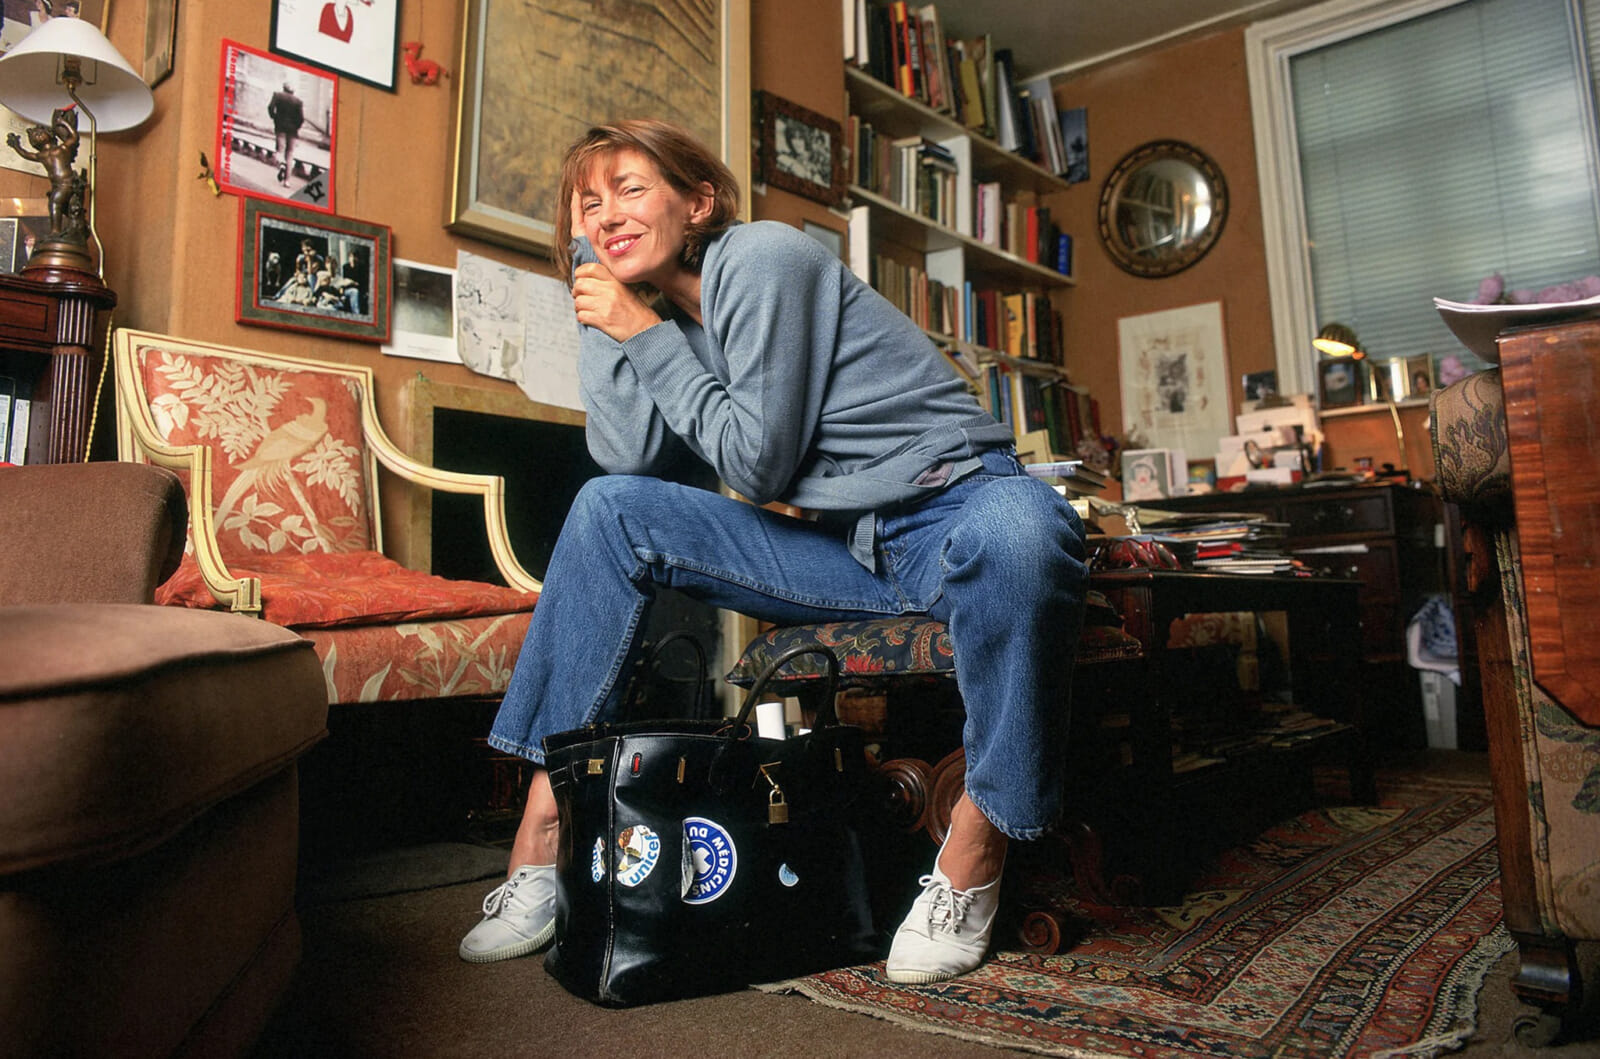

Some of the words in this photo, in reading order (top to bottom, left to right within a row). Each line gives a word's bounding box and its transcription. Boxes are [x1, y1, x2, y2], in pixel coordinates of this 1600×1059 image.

[689, 826, 708, 838] DU
[629, 834, 659, 884] unicef
[692, 836, 731, 895] MÉDECINS
